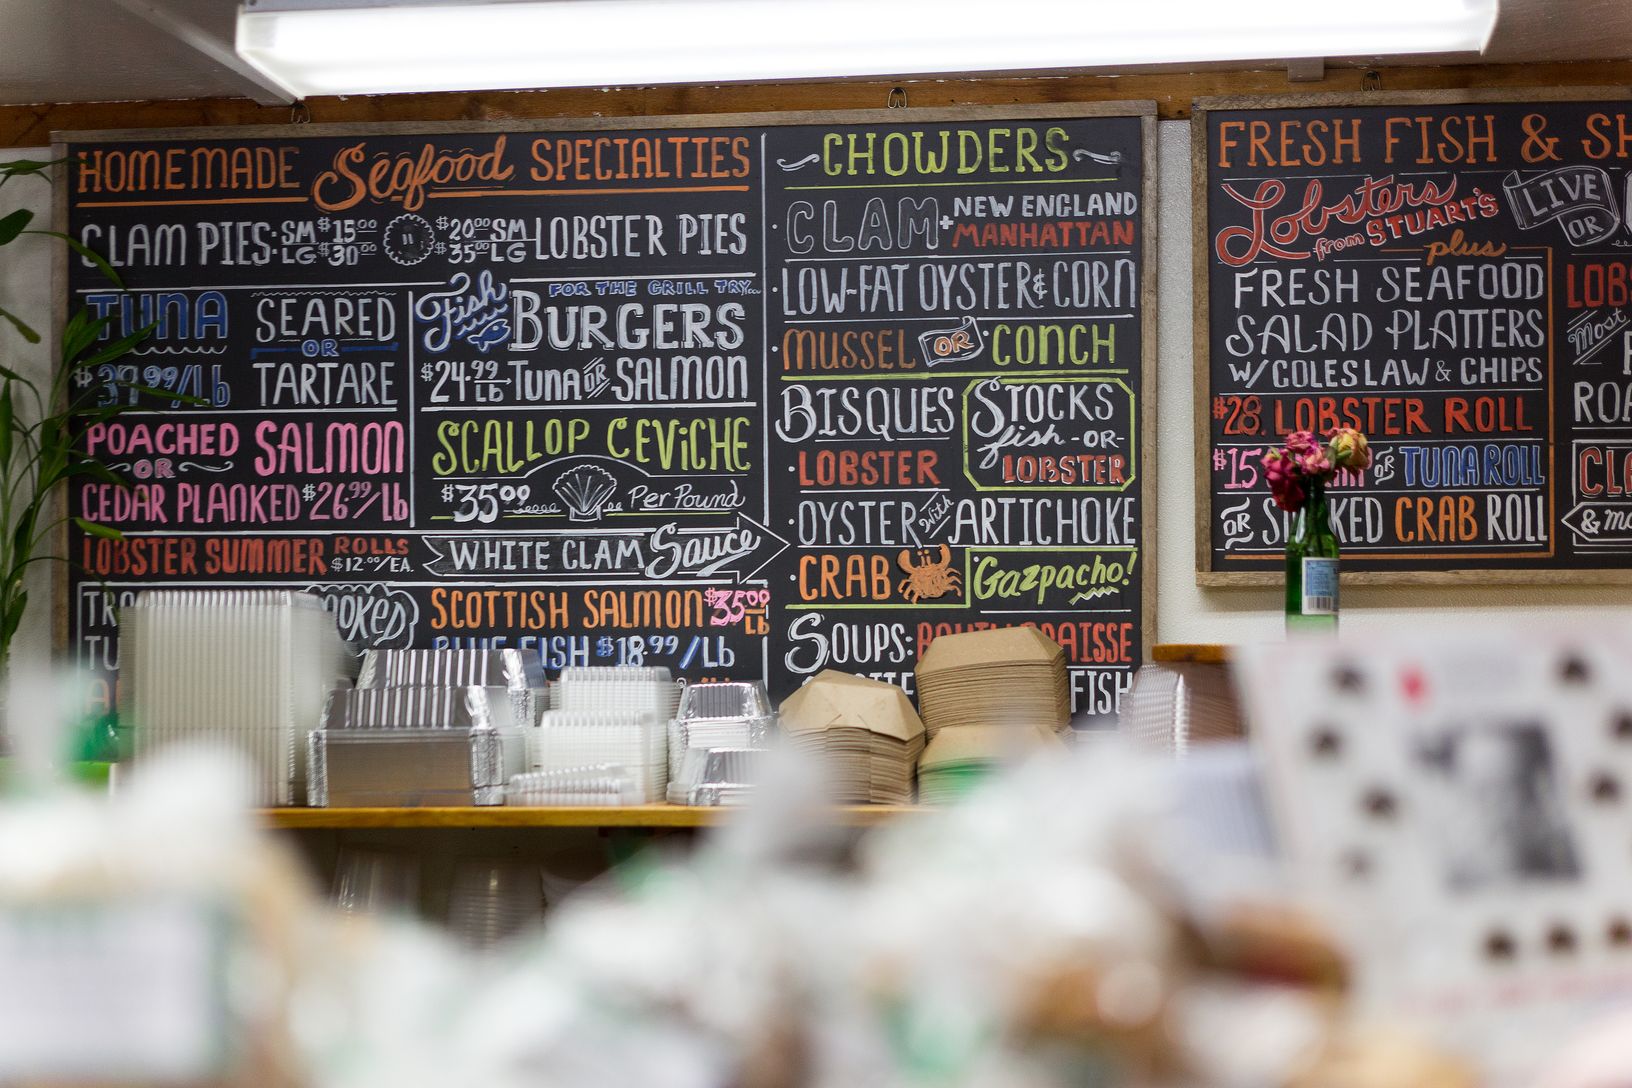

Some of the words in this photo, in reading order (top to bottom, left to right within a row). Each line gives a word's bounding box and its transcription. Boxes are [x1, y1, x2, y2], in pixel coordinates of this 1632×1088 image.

[823, 127, 1070, 176] CHOWDERS
[1217, 118, 1362, 168] FRESH
[1384, 115, 1498, 164] FISH
[1520, 113, 1562, 163] &
[76, 146, 300, 194] HOMEMADE
[311, 134, 515, 211] Seafood
[530, 136, 751, 182] SPECIALTIES
[1523, 174, 1601, 217] LIVE
[786, 197, 940, 254] CLAM
[954, 195, 1014, 218] NEW
[1022, 191, 1138, 217] ENGLAND
[1215, 173, 1458, 267] Lobsters
[1313, 232, 1365, 261] from
[1368, 187, 1499, 247] STUART'S
[1568, 216, 1605, 238] OR
[81, 222, 187, 268] CLAM
[282, 220, 316, 244] SM
[491, 218, 528, 241] SM
[491, 242, 527, 263] LG
[535, 214, 667, 260] LOBSTER
[676, 213, 747, 255] PIES
[951, 220, 1135, 248] MANHATTAN
[1424, 228, 1507, 267] plus
[282, 244, 316, 265] LG
[549, 282, 591, 297] FOR
[596, 281, 638, 297] THE
[648, 280, 709, 296] GRILL
[782, 263, 909, 316] LOW-FAT
[919, 261, 1043, 310] OYSTER
[1053, 258, 1137, 309] CORN
[1234, 267, 1359, 308] FRESH
[1376, 262, 1545, 303] SEAFOOD
[87, 291, 228, 341] TUNA
[255, 297, 397, 343] SEARED
[415, 269, 509, 351] Fish
[508, 289, 747, 351] BURGERS
[1225, 310, 1374, 356] SALAD
[1386, 308, 1546, 351] PLATTERS
[1567, 308, 1627, 355] Most
[301, 338, 340, 358] OR
[783, 328, 917, 370] MUSSEL
[934, 330, 975, 356] OR
[992, 323, 1116, 367] CONCH
[252, 361, 398, 407] TARTARE
[584, 364, 608, 393] OR
[611, 355, 748, 401] SALMON
[1435, 359, 1452, 382] &
[1460, 355, 1544, 386] CHIPS
[775, 384, 955, 443] BISQUES
[971, 376, 1114, 438] STOCKS
[1274, 396, 1433, 438] LOBSTER
[1444, 396, 1534, 434] ROLL
[85, 421, 239, 457] POACHED
[254, 420, 406, 477] SALMON
[432, 417, 591, 477] SCALLOP
[976, 423, 1067, 470] fish
[133, 458, 176, 479] OR
[799, 450, 942, 487] LOBSTER
[1002, 453, 1127, 485] LOBSTER
[1374, 455, 1396, 478] OR
[1399, 445, 1480, 488] TUNA
[1483, 443, 1546, 487] ROLL
[81, 482, 168, 524] CEDAR
[176, 482, 301, 524] PLANKED
[628, 484, 673, 509] Per
[673, 480, 746, 509] Pound
[799, 500, 923, 549] OYSTER
[949, 497, 1136, 546] ARTICHOKE
[1223, 512, 1252, 537] OR
[1262, 497, 1383, 545] SKED
[1395, 495, 1479, 543] CRAB
[1486, 492, 1549, 543] ROLL
[1581, 509, 1601, 534] &
[83, 537, 198, 577] LOBSTER
[205, 537, 328, 576] SUMMER
[334, 537, 410, 555] ROLLS
[449, 539, 551, 570] WHITE
[562, 539, 645, 571] CLAM
[645, 523, 761, 579] Sauce
[800, 554, 892, 601] CRAB
[973, 551, 1138, 605] Gazpacho!
[430, 587, 568, 629] SCOTTISH
[583, 588, 705, 629] SALMON
[1070, 670, 1133, 715] FISH
